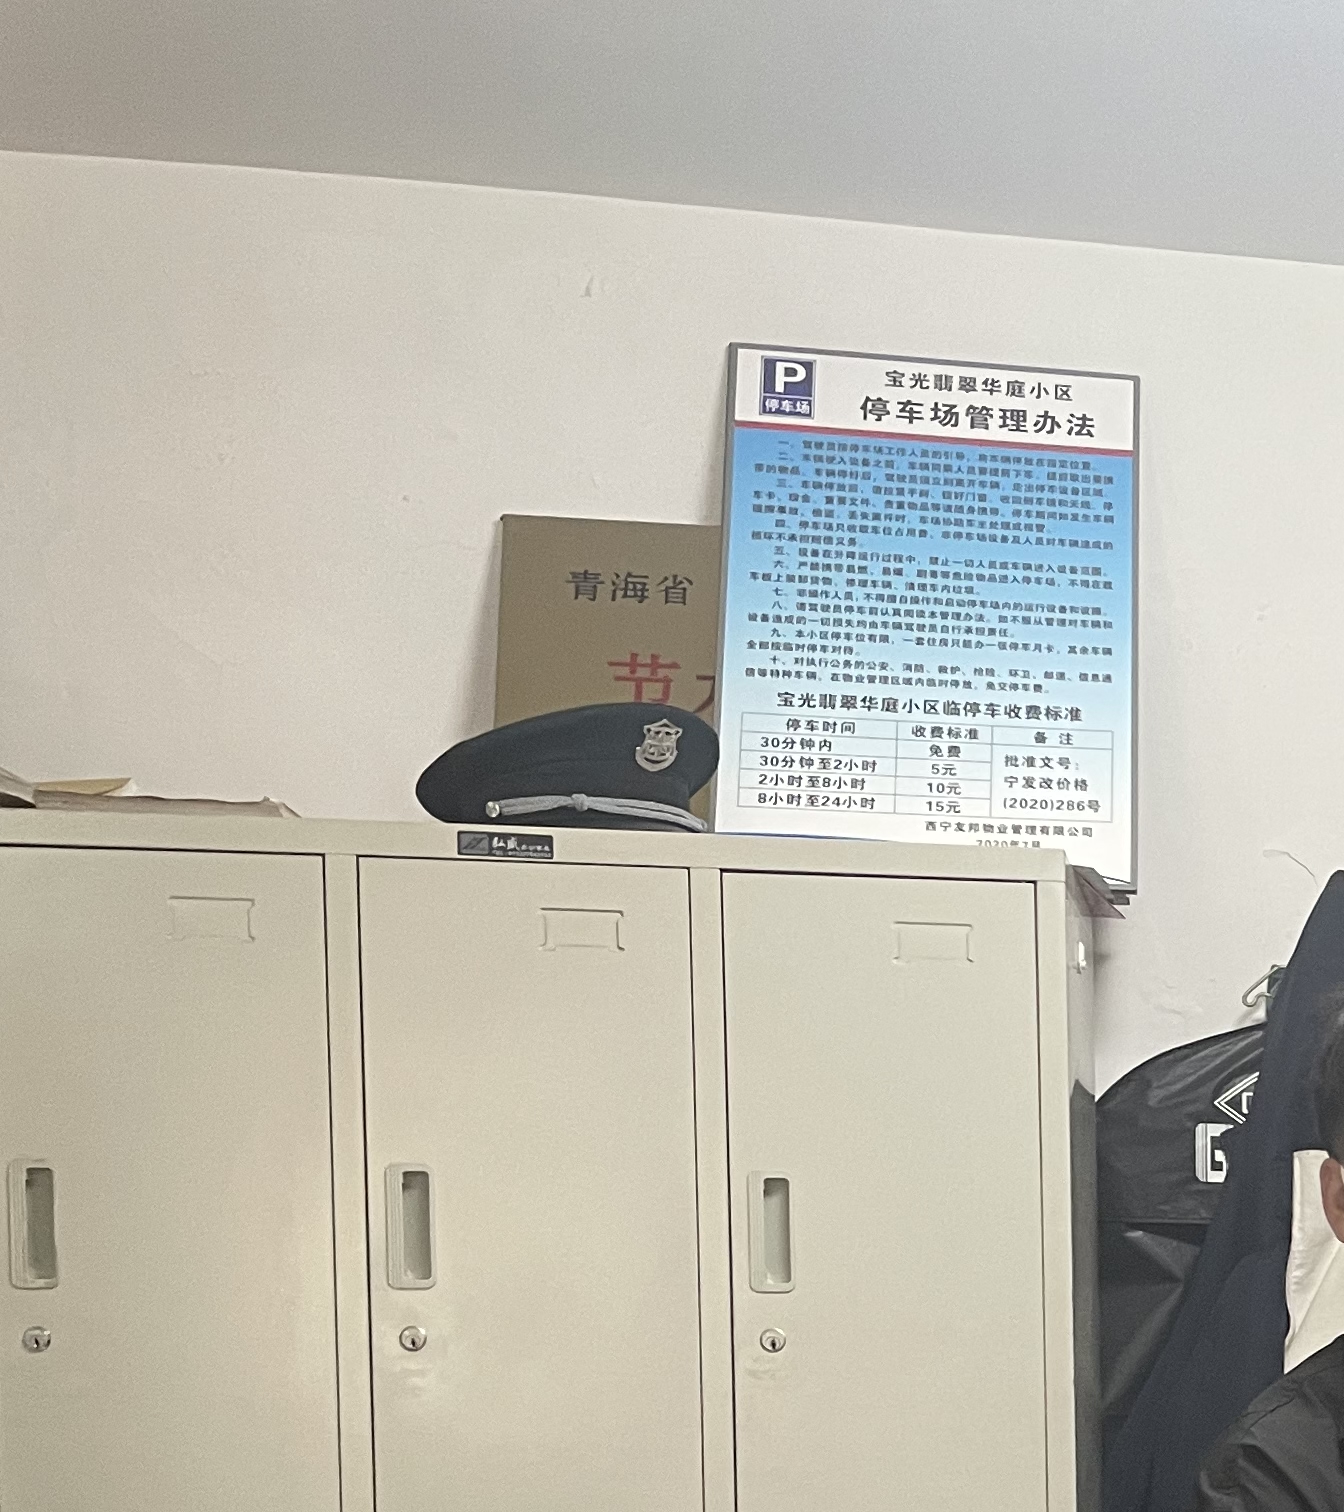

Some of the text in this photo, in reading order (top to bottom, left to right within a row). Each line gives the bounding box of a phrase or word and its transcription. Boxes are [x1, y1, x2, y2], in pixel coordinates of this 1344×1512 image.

[774, 361, 806, 393] P
[884, 370, 1074, 401] 宝光翡翠华庭小区
[764, 398, 811, 416] 停车场
[860, 396, 1097, 438] 停车场管理办法
[565, 568, 694, 606] 青海省
[777, 692, 1083, 722] 宝光翡翠华庭小区临停车收费标准
[786, 718, 856, 735] 停车时间
[910, 726, 979, 741] 收费标准
[760, 737, 961, 759] 30分钟内 免费
[759, 755, 877, 774] 30分钟至2小时
[931, 763, 957, 777] 5元
[758, 773, 1089, 796] 2小时至8小时 10元 宁发改价格
[757, 792, 876, 810] 8小时至24小时
[925, 800, 961, 815] 15元
